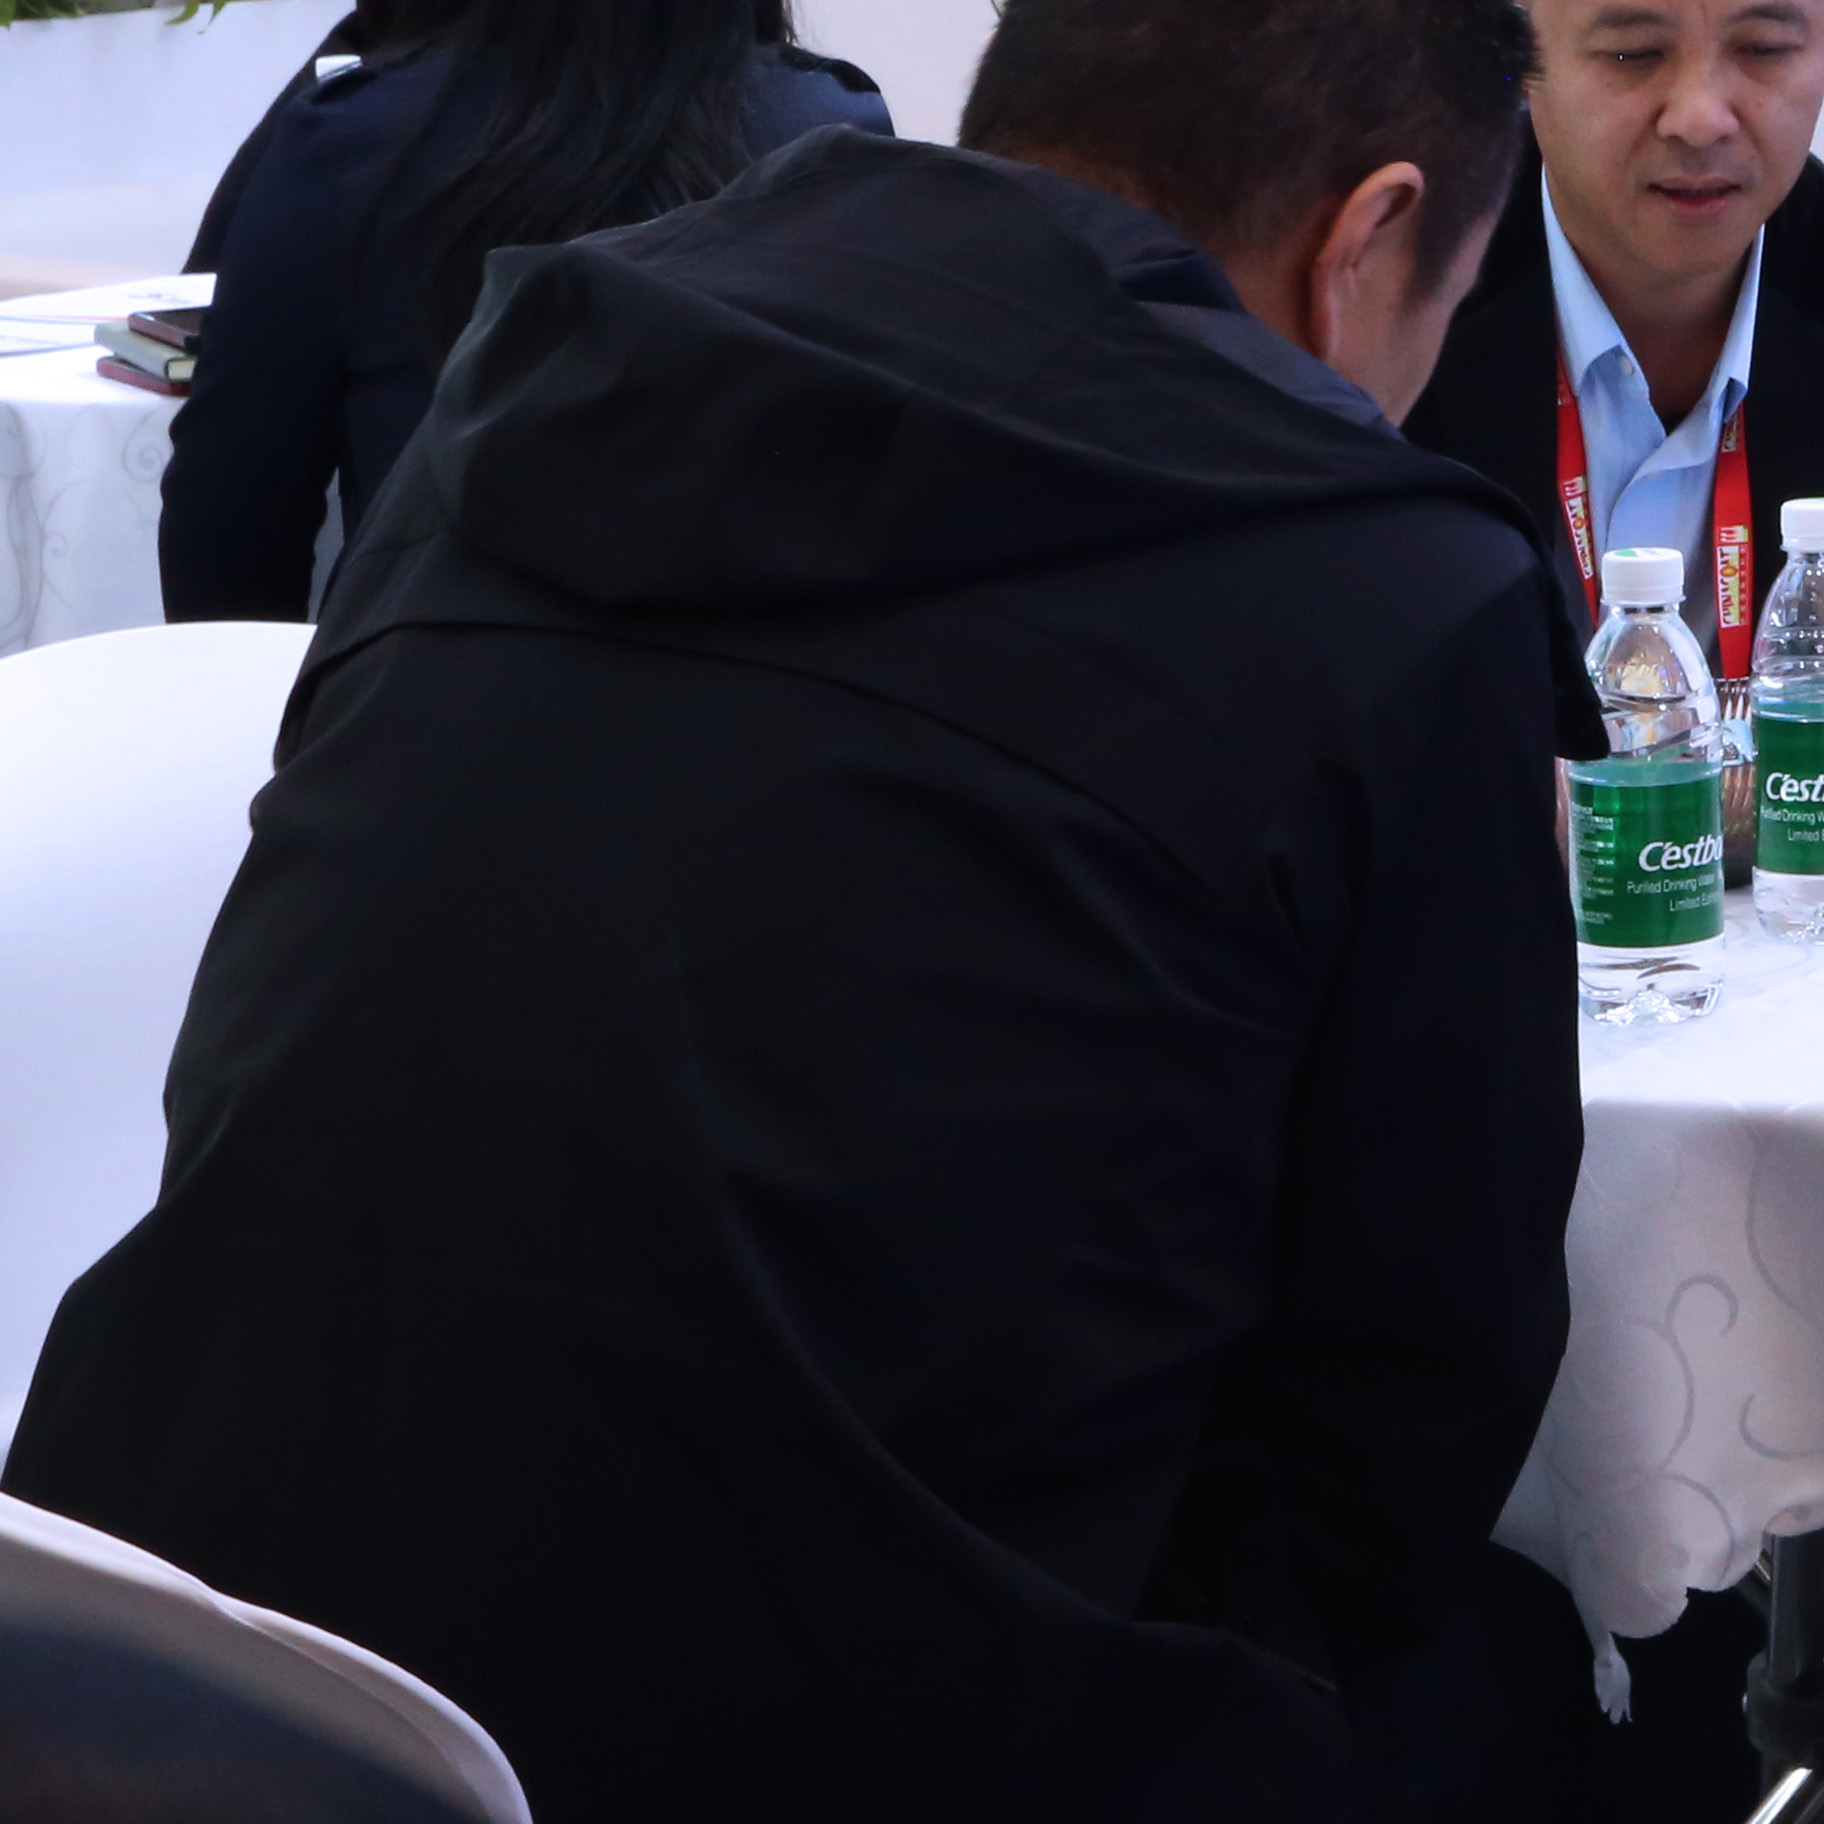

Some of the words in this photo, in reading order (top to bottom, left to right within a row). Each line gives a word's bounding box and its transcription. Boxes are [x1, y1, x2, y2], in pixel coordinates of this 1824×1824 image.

[1782, 807, 1816, 825] Drinking
[1787, 827, 1820, 842] Limited
[1627, 880, 1662, 895] Purified
[1662, 877, 1698, 893] Drinking
[1669, 896, 1701, 912] Limited
